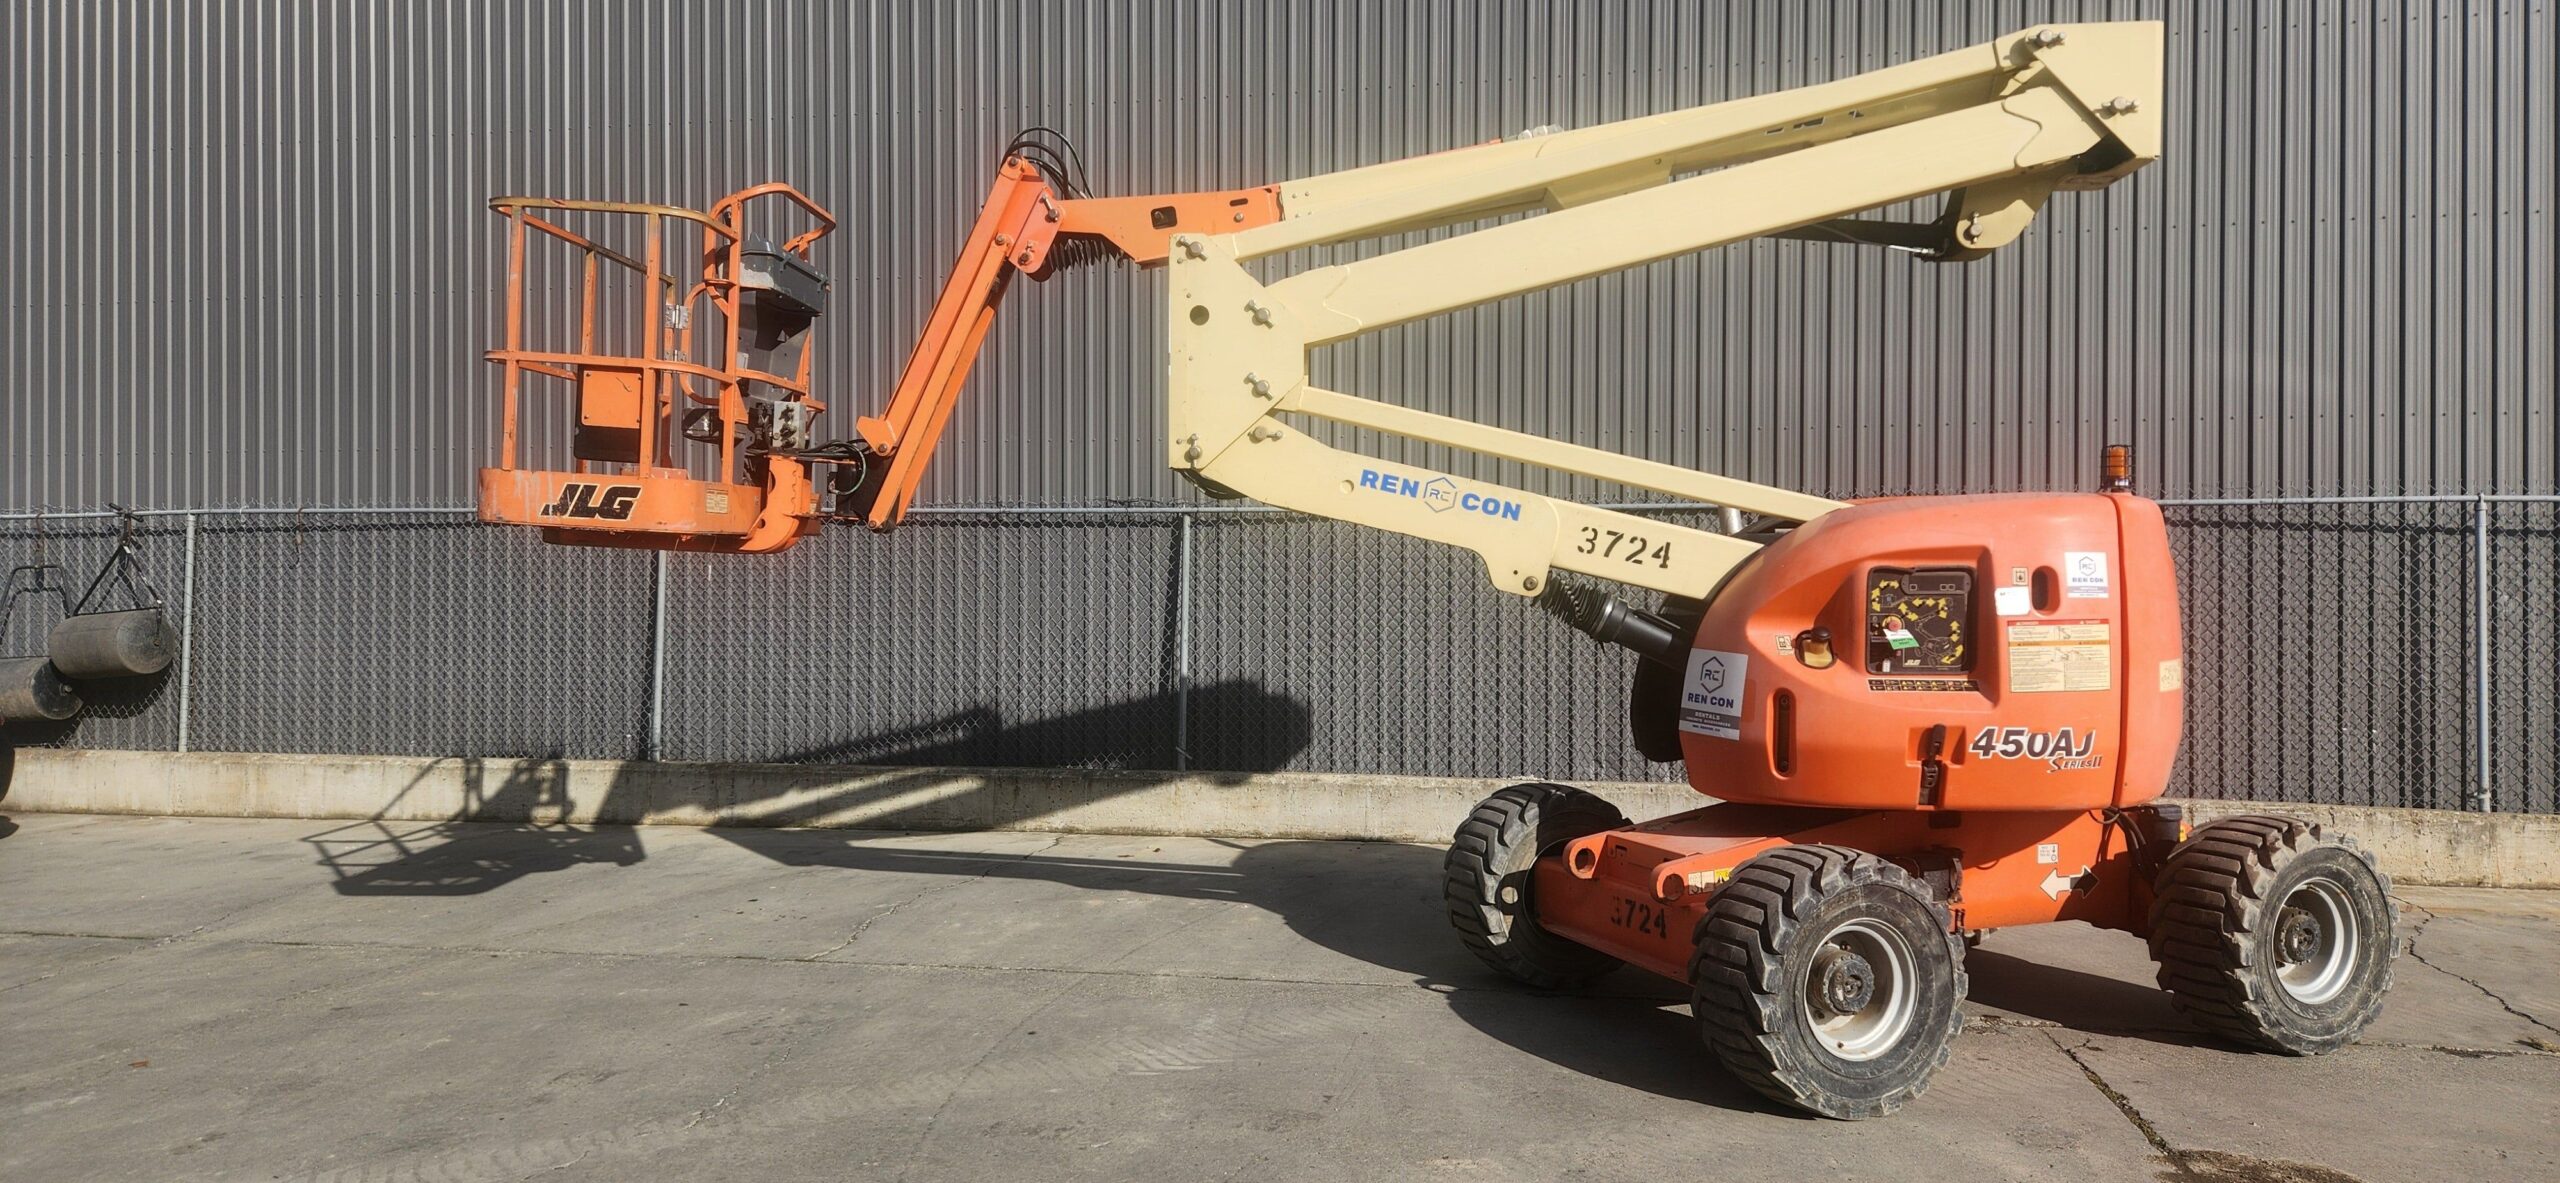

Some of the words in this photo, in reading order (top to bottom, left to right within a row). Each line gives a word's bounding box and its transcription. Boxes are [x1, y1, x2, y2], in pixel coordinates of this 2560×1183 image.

[540, 483, 642, 521] JLG
[1360, 469, 1420, 498] REN
[1461, 493, 1522, 521] CON
[1577, 526, 1671, 569] 3724
[1688, 692, 1708, 705] REN
[1710, 696, 1734, 709] CON
[1969, 726, 2096, 760] 450AJ
[1611, 895, 1667, 939] 3724
